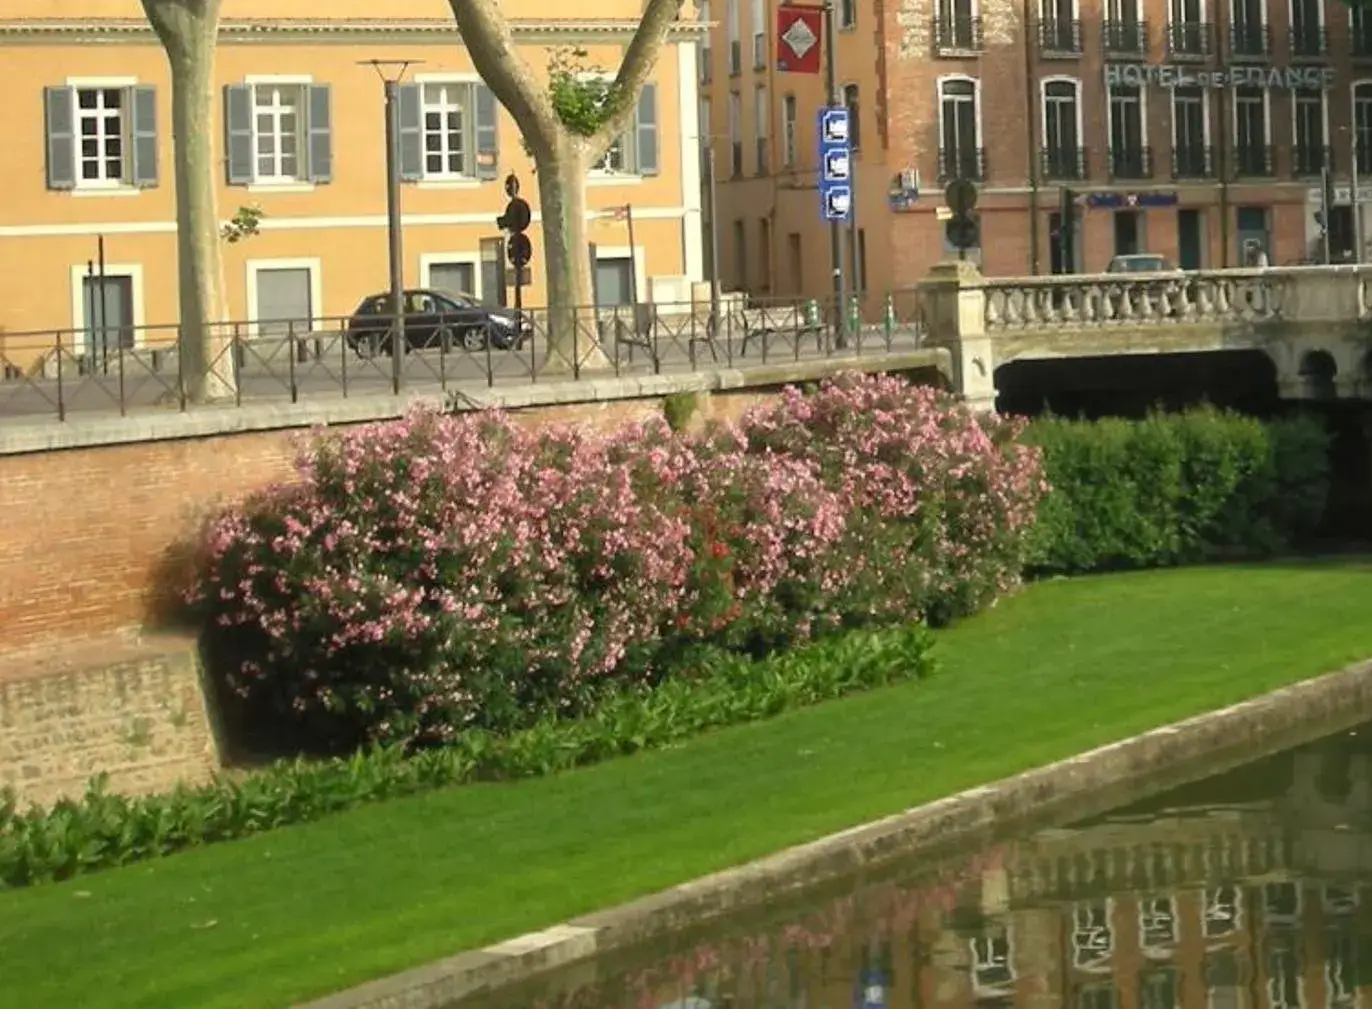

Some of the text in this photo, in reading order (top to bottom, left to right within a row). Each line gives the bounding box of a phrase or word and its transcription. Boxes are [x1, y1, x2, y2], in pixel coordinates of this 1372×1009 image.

[1104, 64, 1338, 90] HOTEL DE FRANCE
